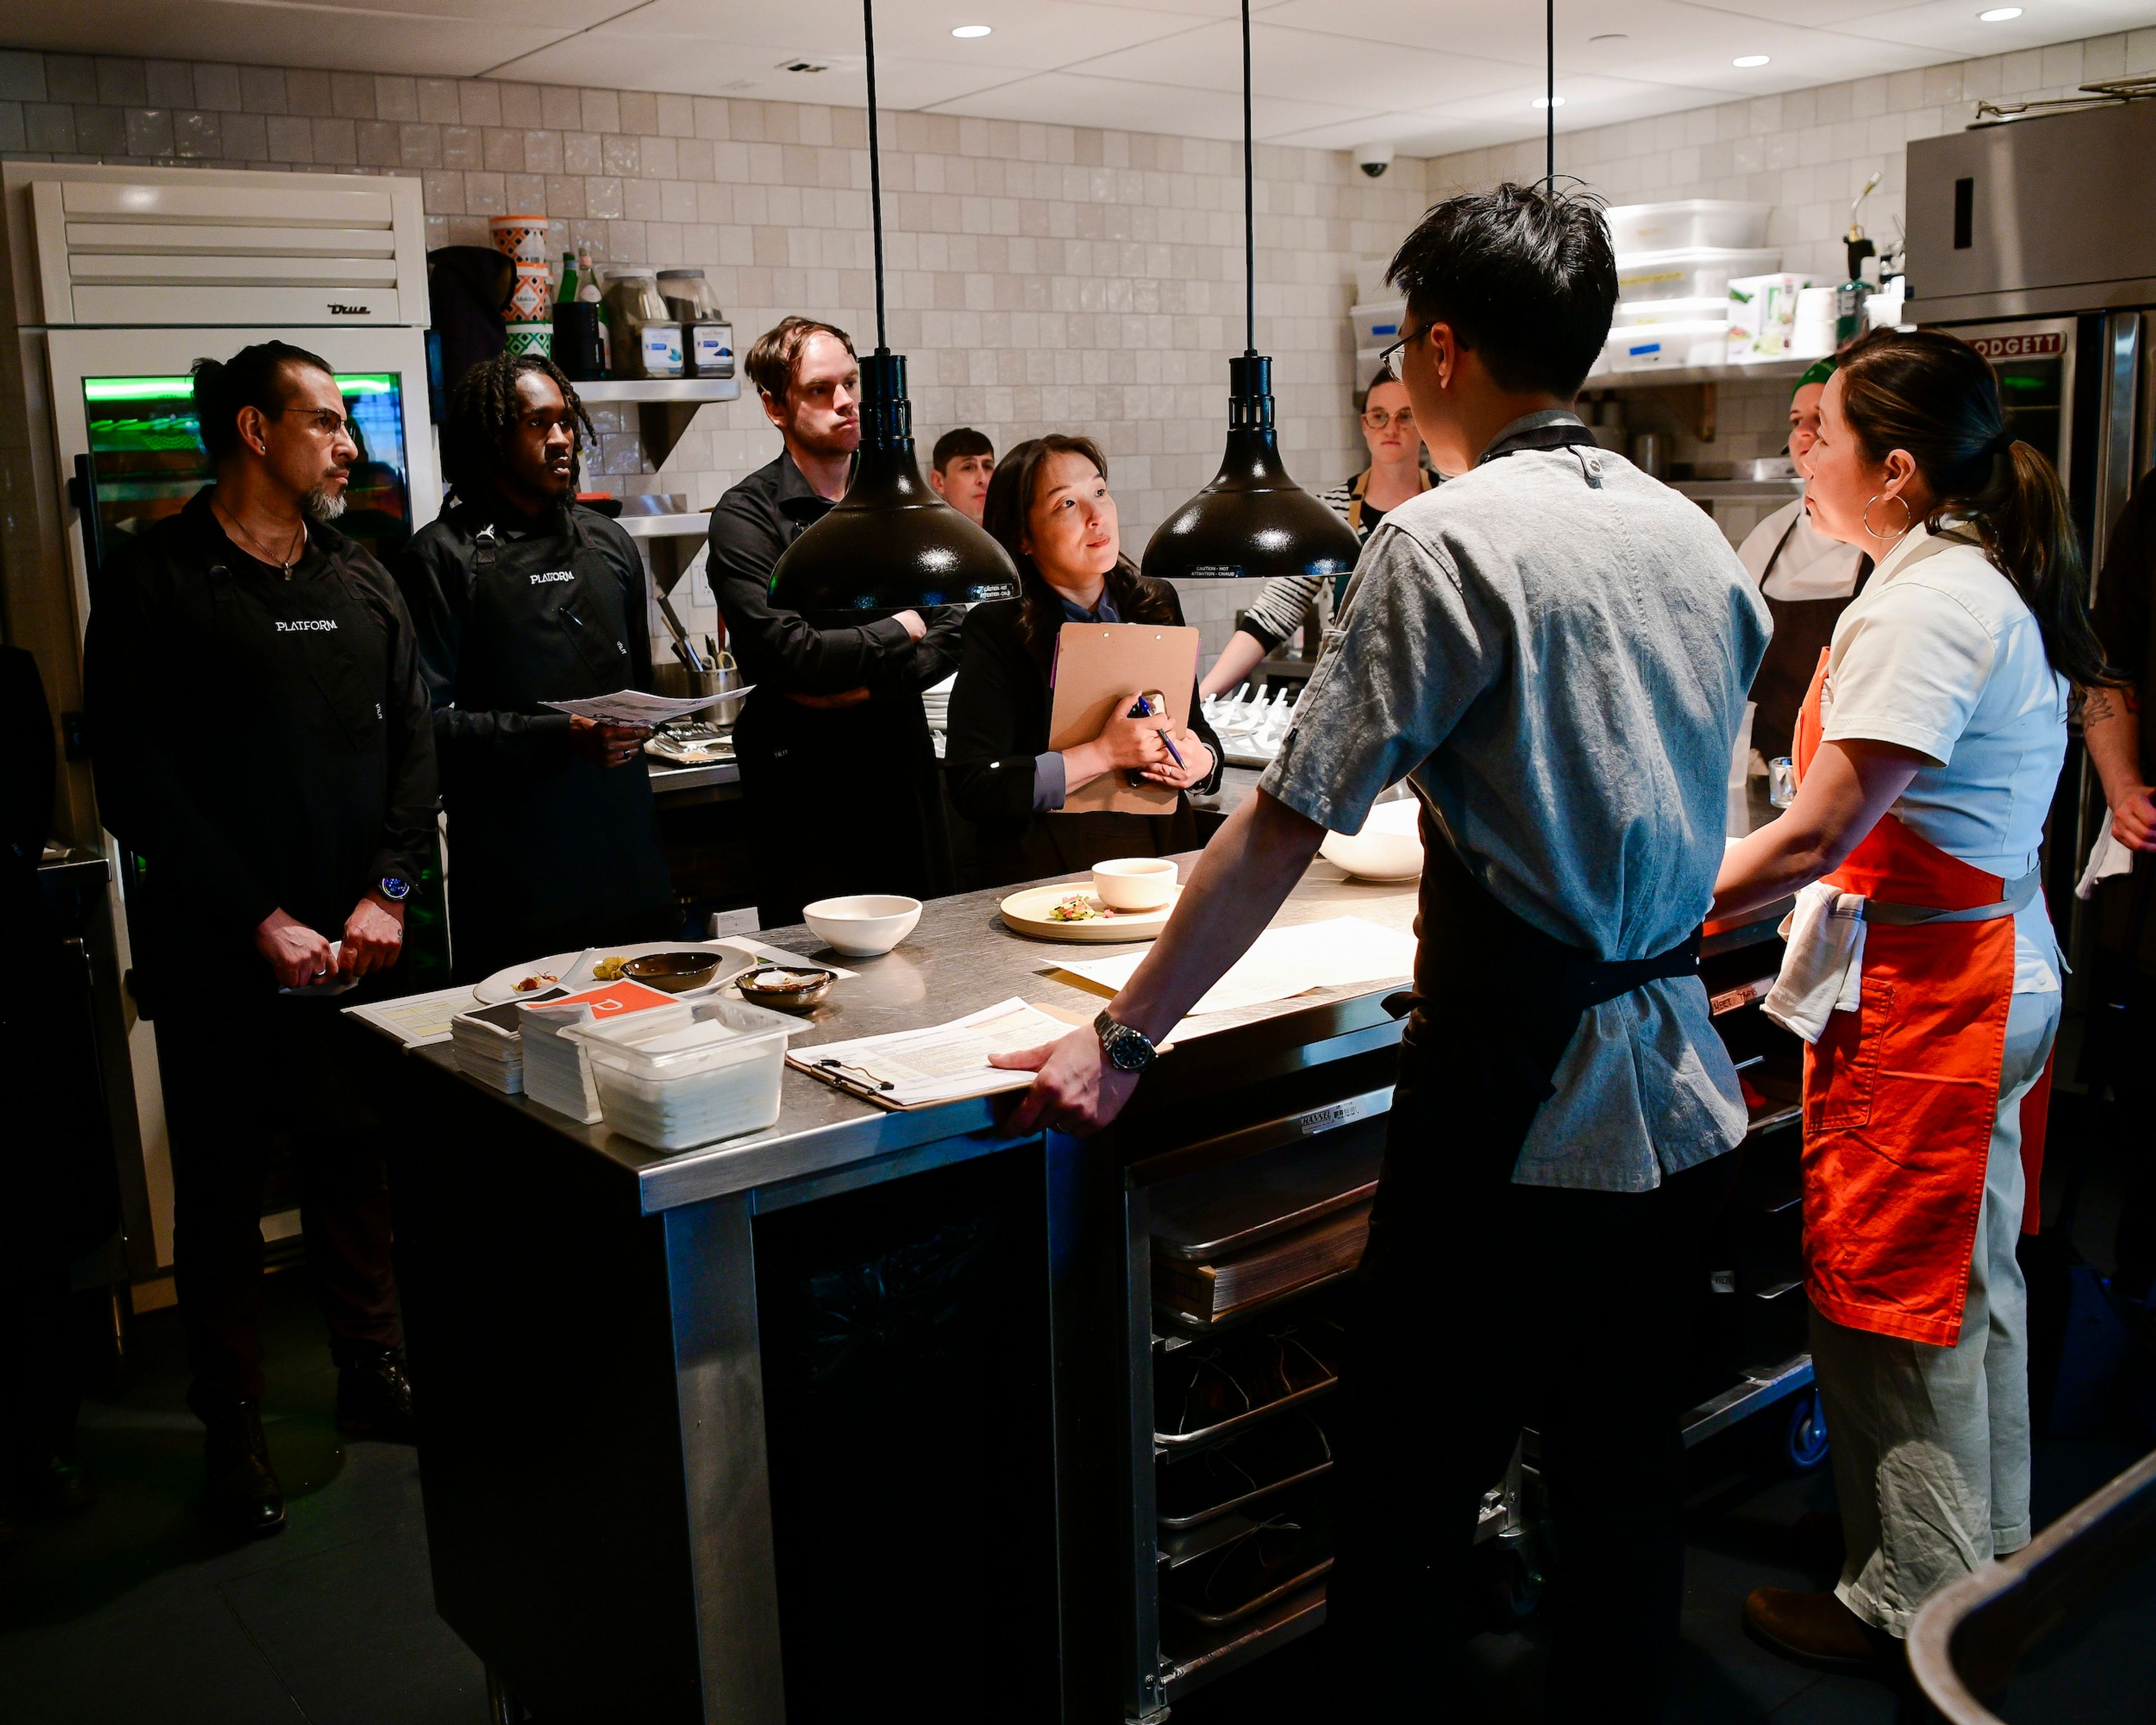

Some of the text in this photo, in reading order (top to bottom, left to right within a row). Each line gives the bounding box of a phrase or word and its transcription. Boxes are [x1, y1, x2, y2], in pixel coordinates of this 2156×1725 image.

[327, 304, 371, 314] True
[1974, 335, 2056, 356] ODGETT
[529, 571, 575, 585] PLATFORM
[275, 620, 338, 631] PLATFORM
